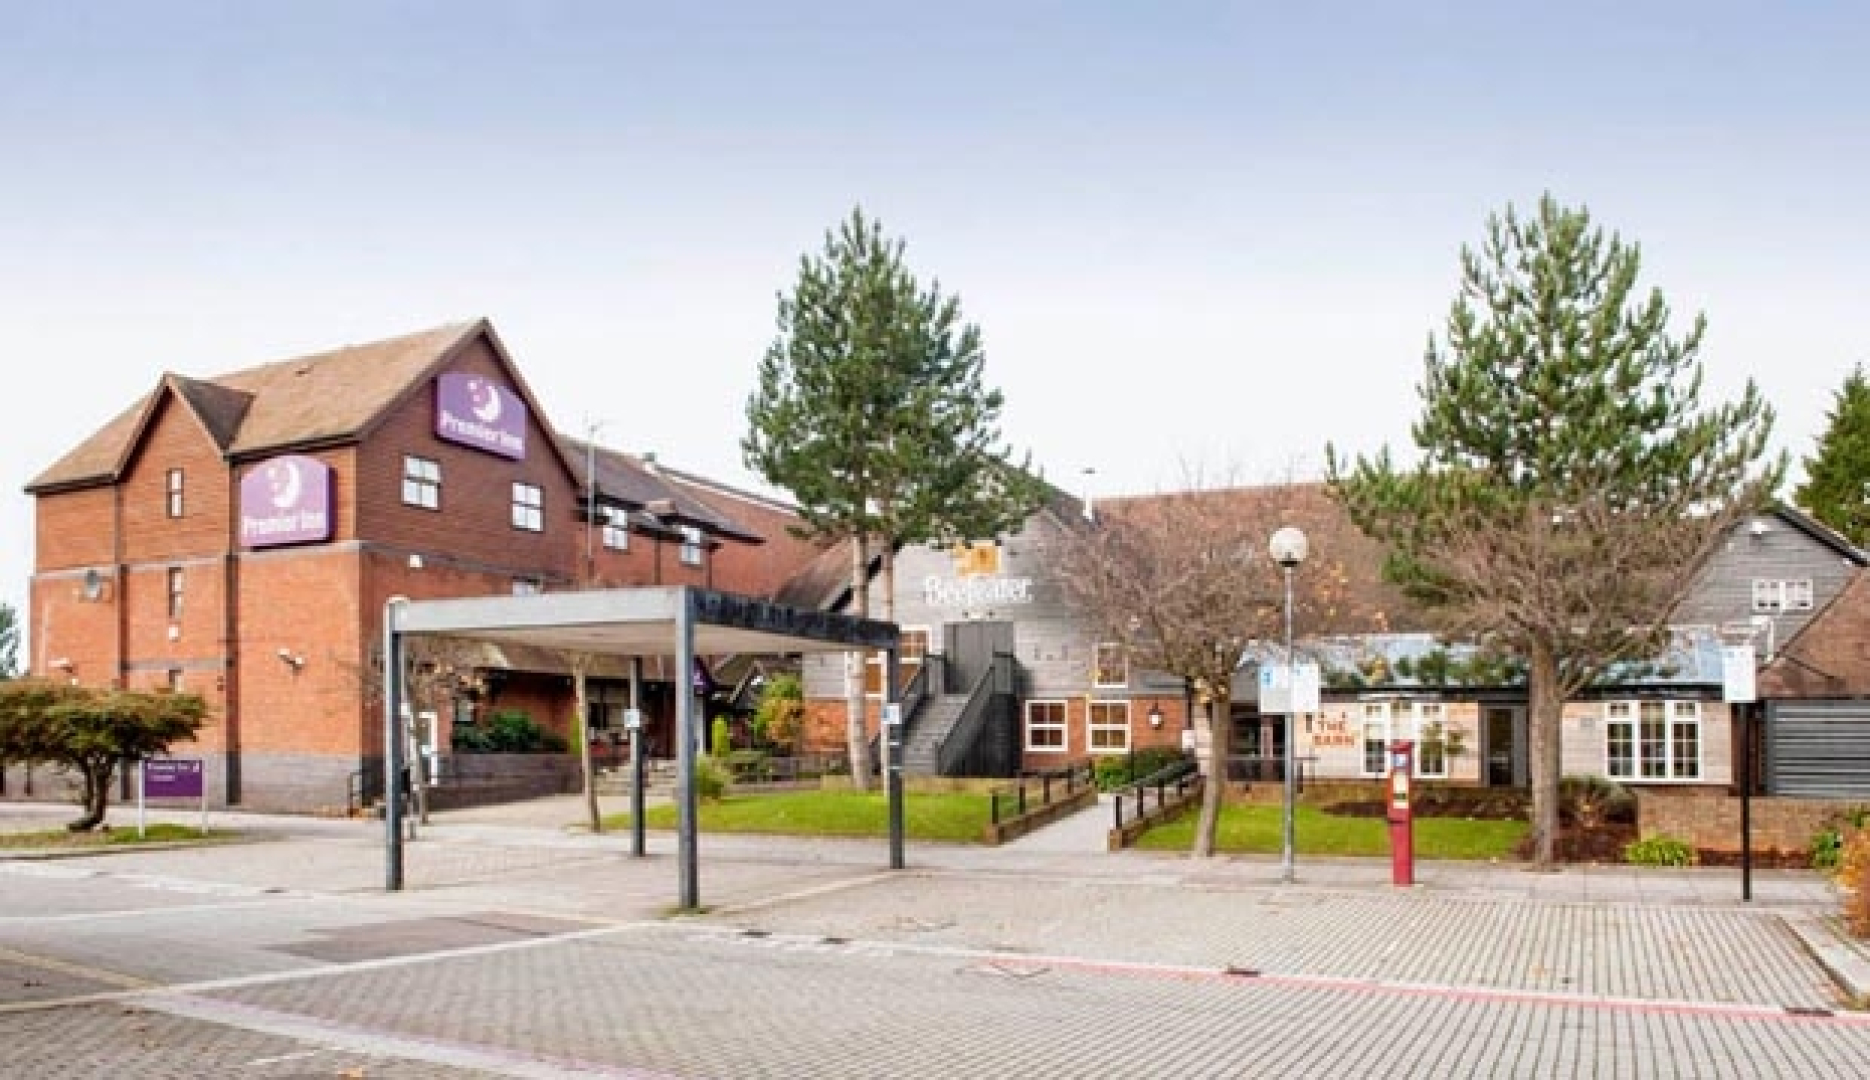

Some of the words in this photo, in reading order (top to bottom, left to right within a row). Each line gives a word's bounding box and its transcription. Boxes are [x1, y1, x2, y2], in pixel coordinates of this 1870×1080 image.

[440, 410, 500, 441] Premier
[242, 515, 297, 537] Premier
[301, 510, 325, 530] Inn
